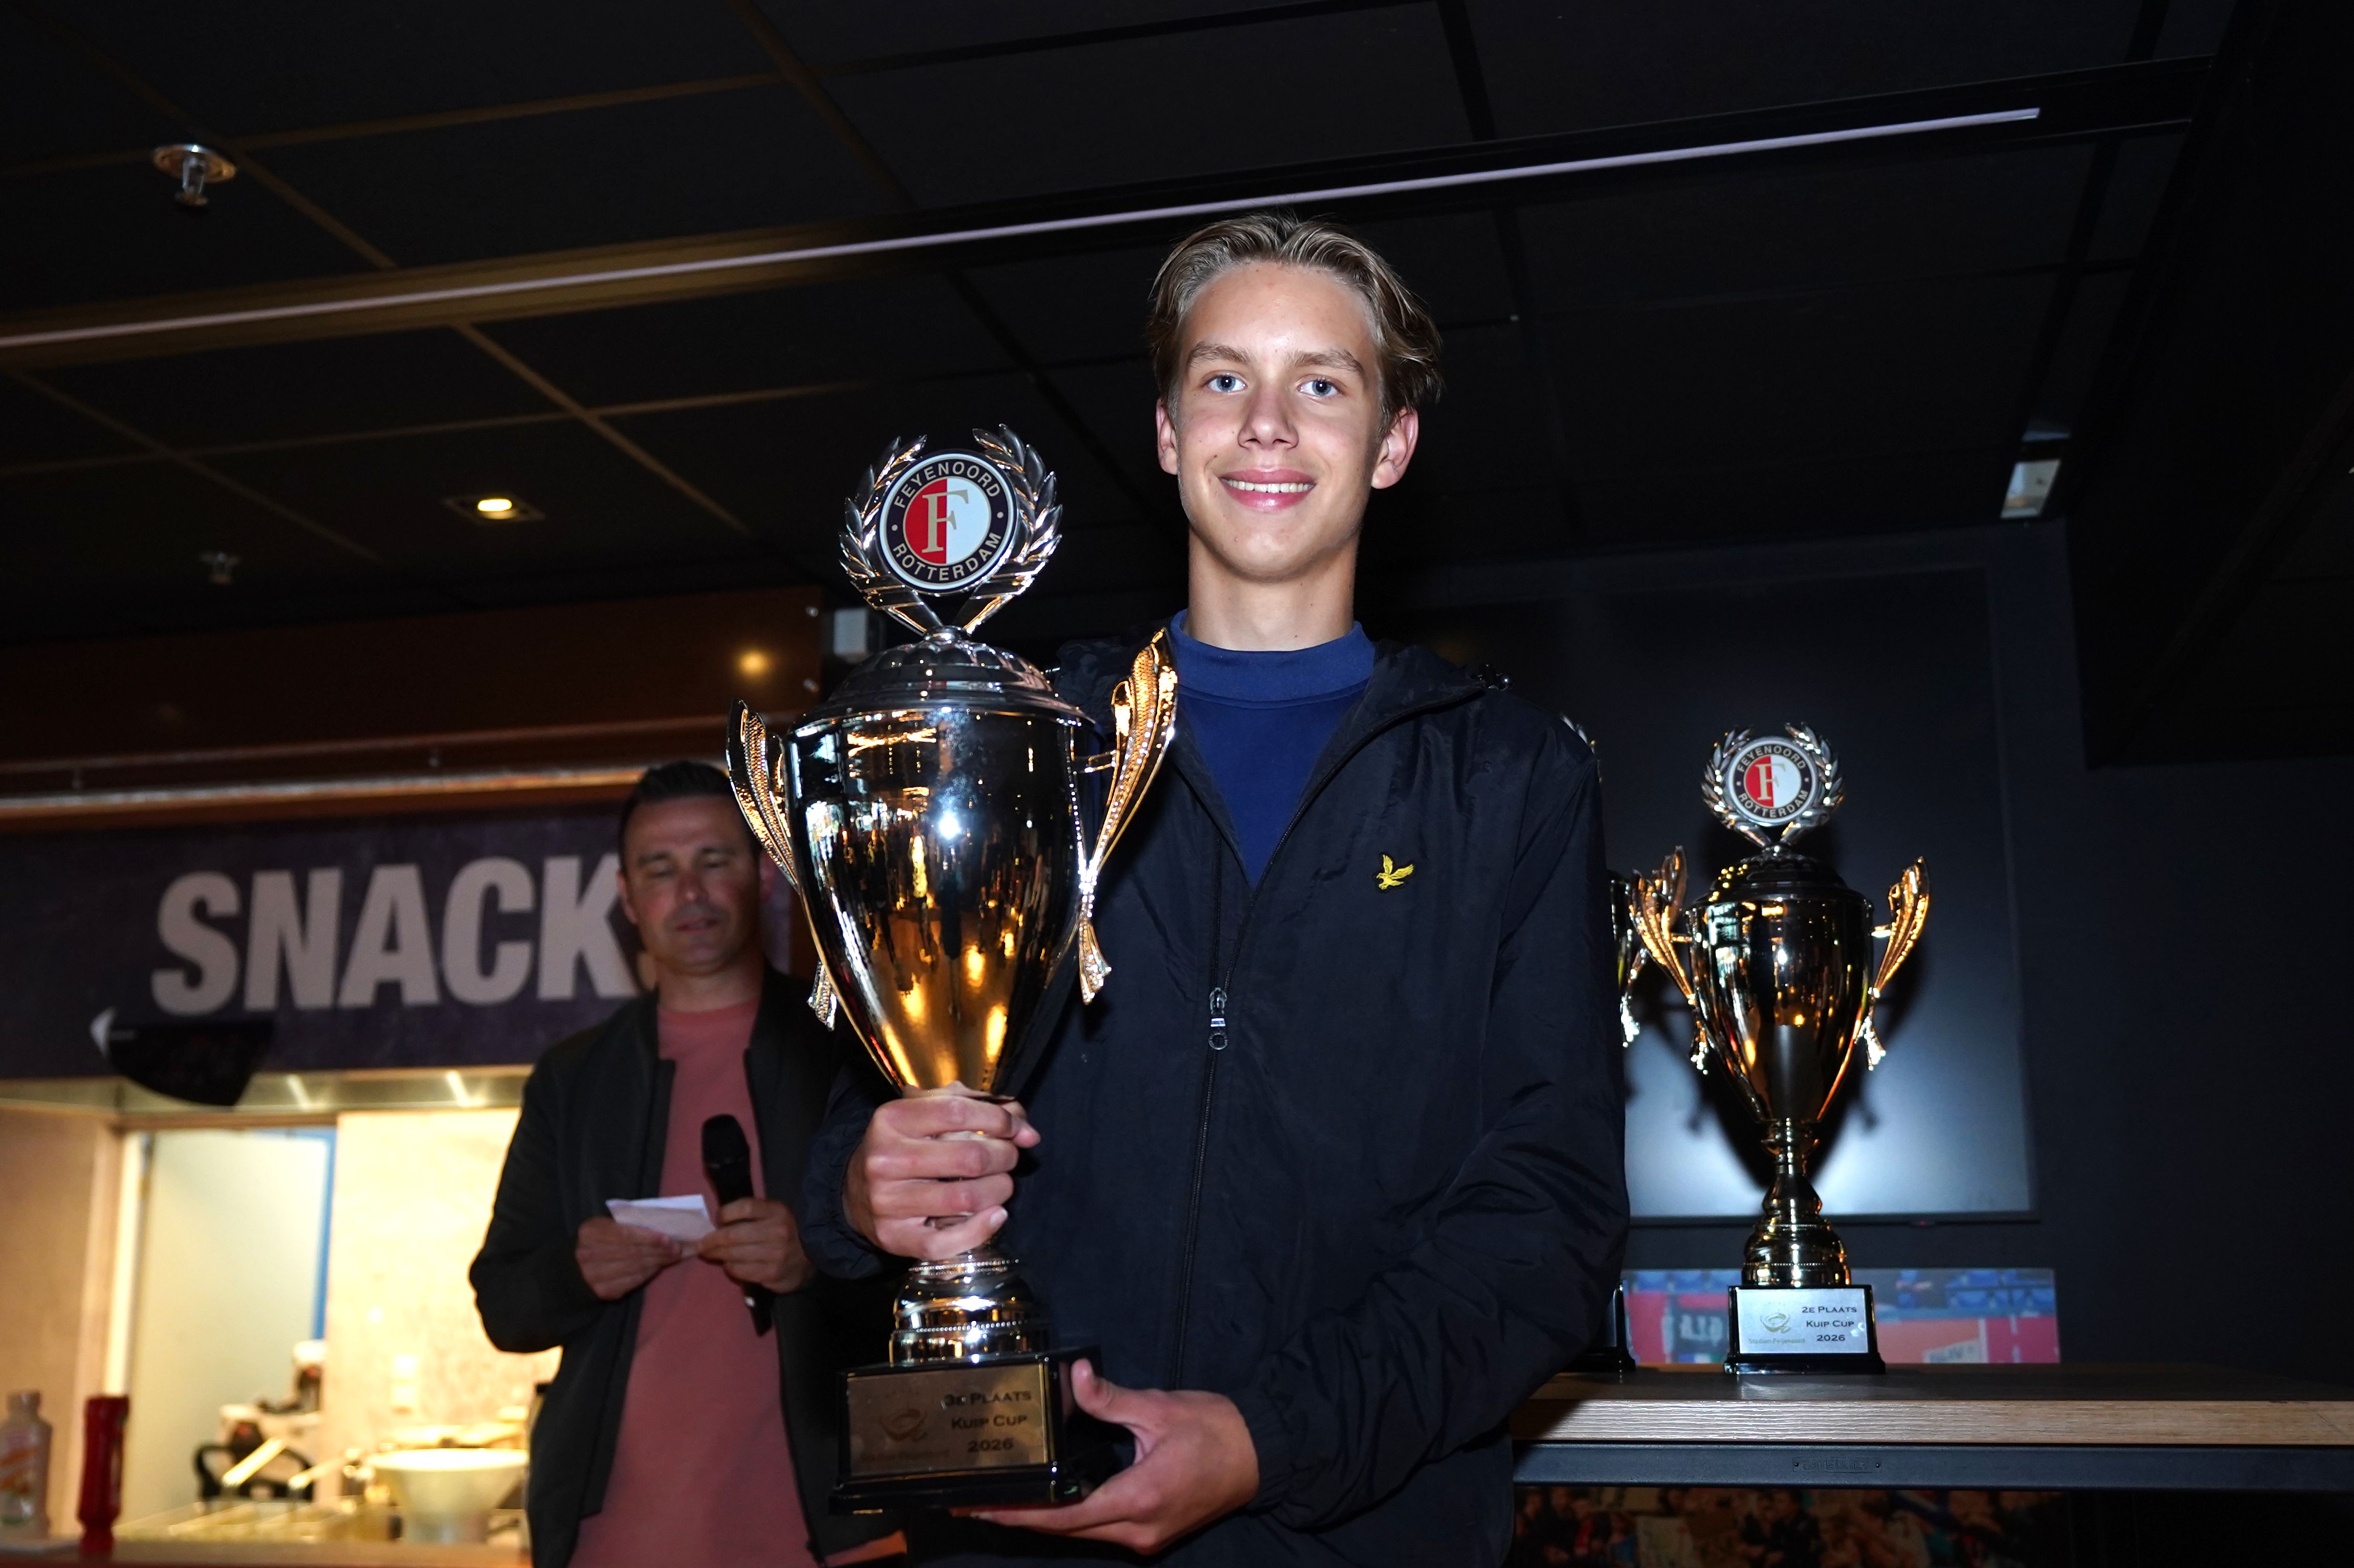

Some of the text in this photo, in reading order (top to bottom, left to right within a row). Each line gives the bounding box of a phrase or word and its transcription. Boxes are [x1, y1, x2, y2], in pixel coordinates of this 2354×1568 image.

[895, 461, 1001, 508] FEYENOORD
[922, 489, 969, 553] F
[893, 532, 1002, 581] ROTTERDAM
[1738, 745, 1806, 772] FEYENOORD
[1755, 763, 1786, 800] F
[1738, 790, 1809, 818] ROTTERDAM
[150, 853, 656, 1015] SNACK
[967, 1438, 1014, 1453] 2026
